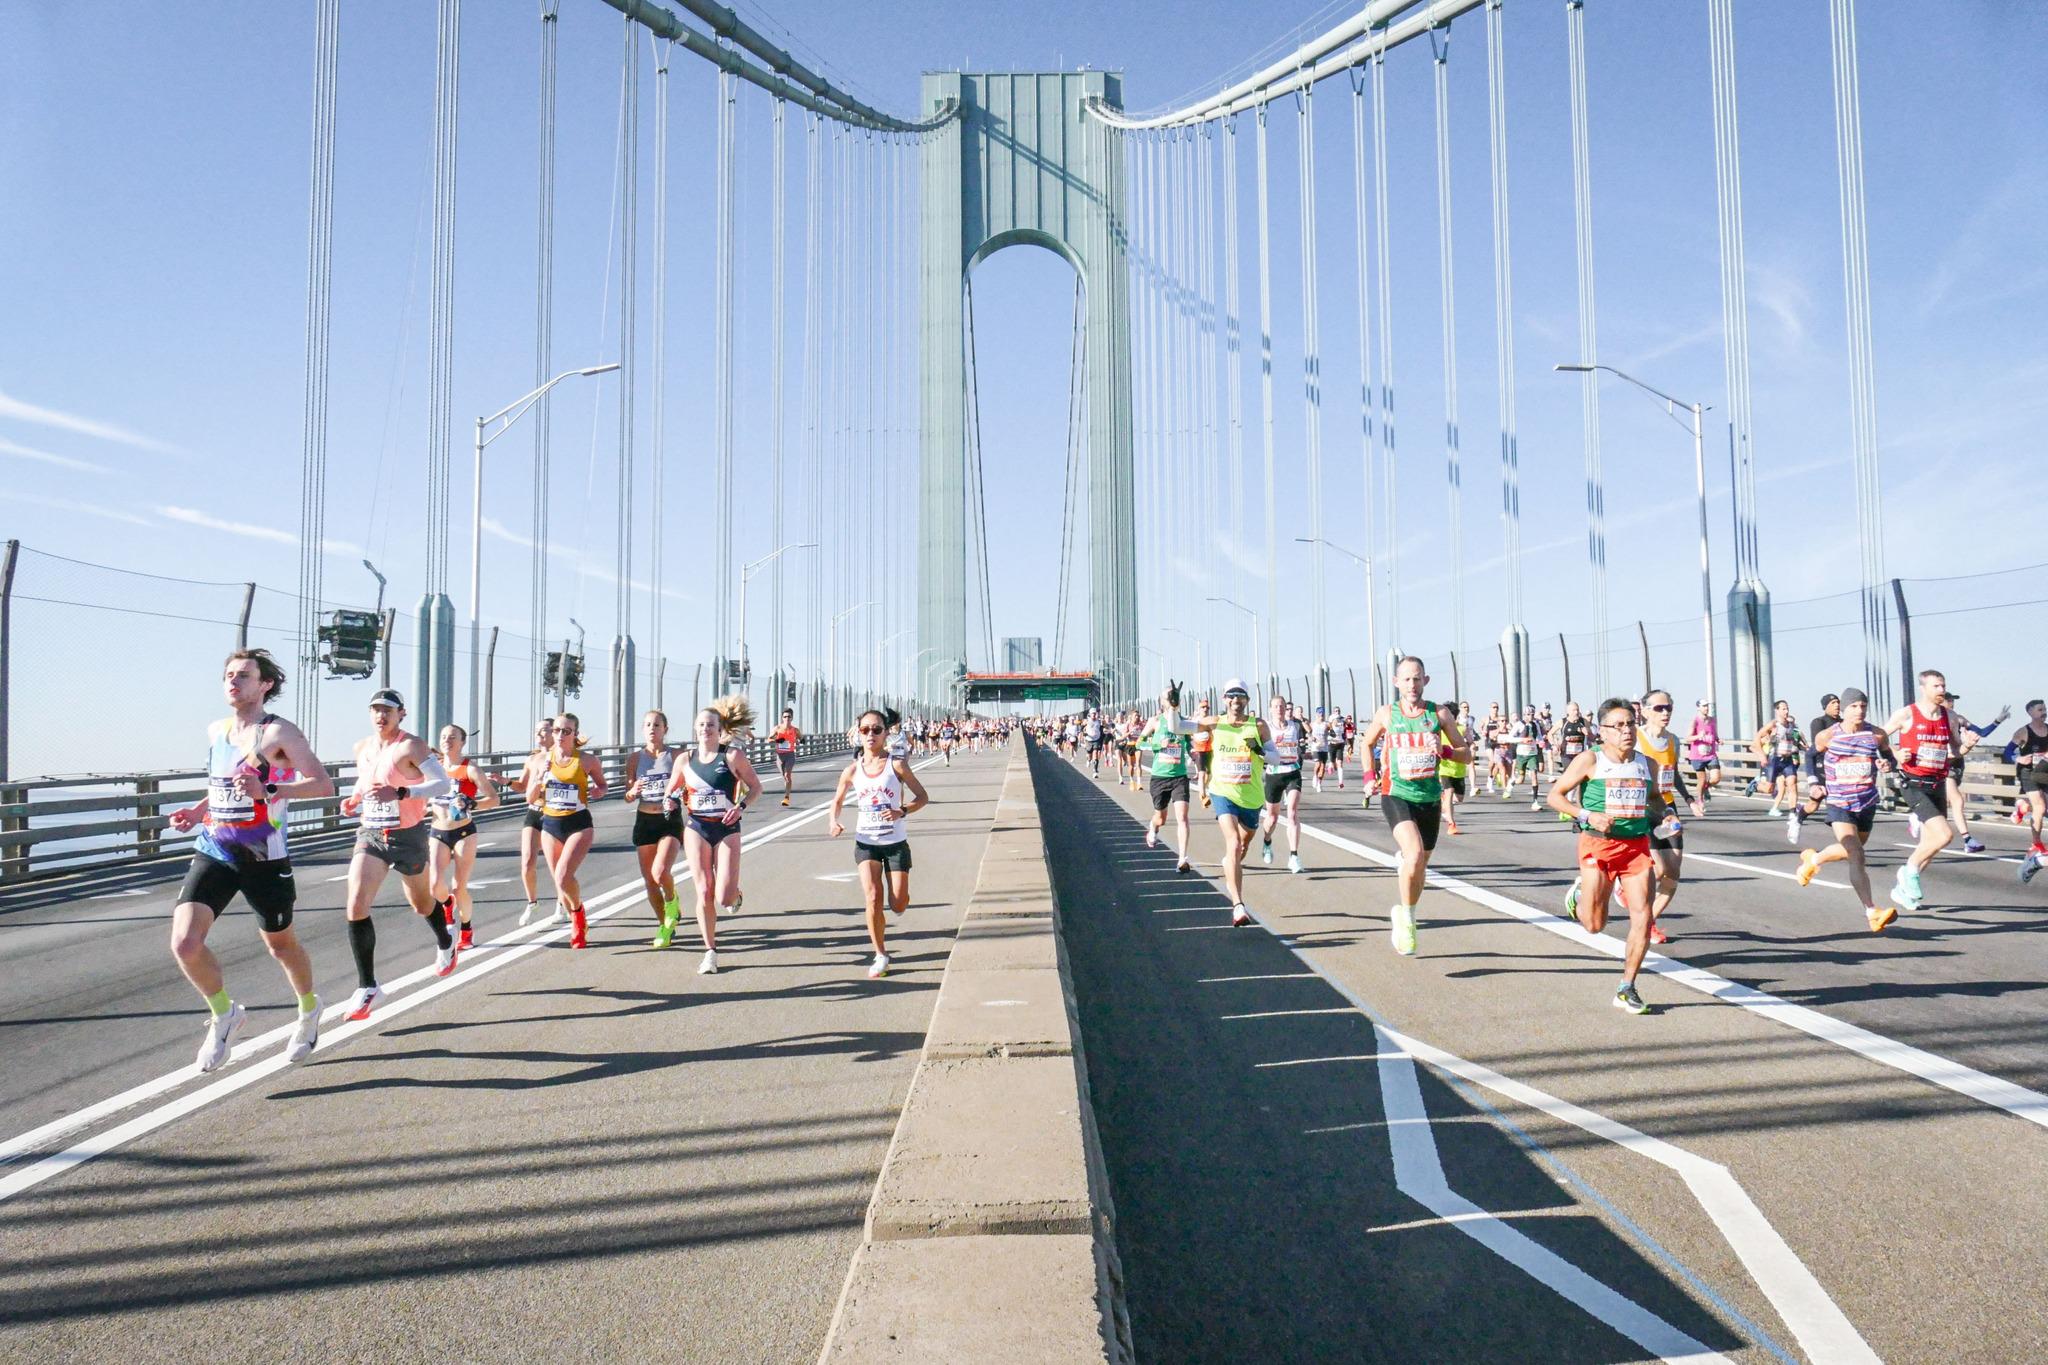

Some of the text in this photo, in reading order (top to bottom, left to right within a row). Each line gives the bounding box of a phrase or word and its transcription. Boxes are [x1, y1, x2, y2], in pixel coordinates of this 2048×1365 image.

[1414, 754, 1435, 763] 1950
[1233, 763, 1251, 771] 1983
[553, 790, 569, 799] 601
[1608, 789, 1645, 799] AG 2271
